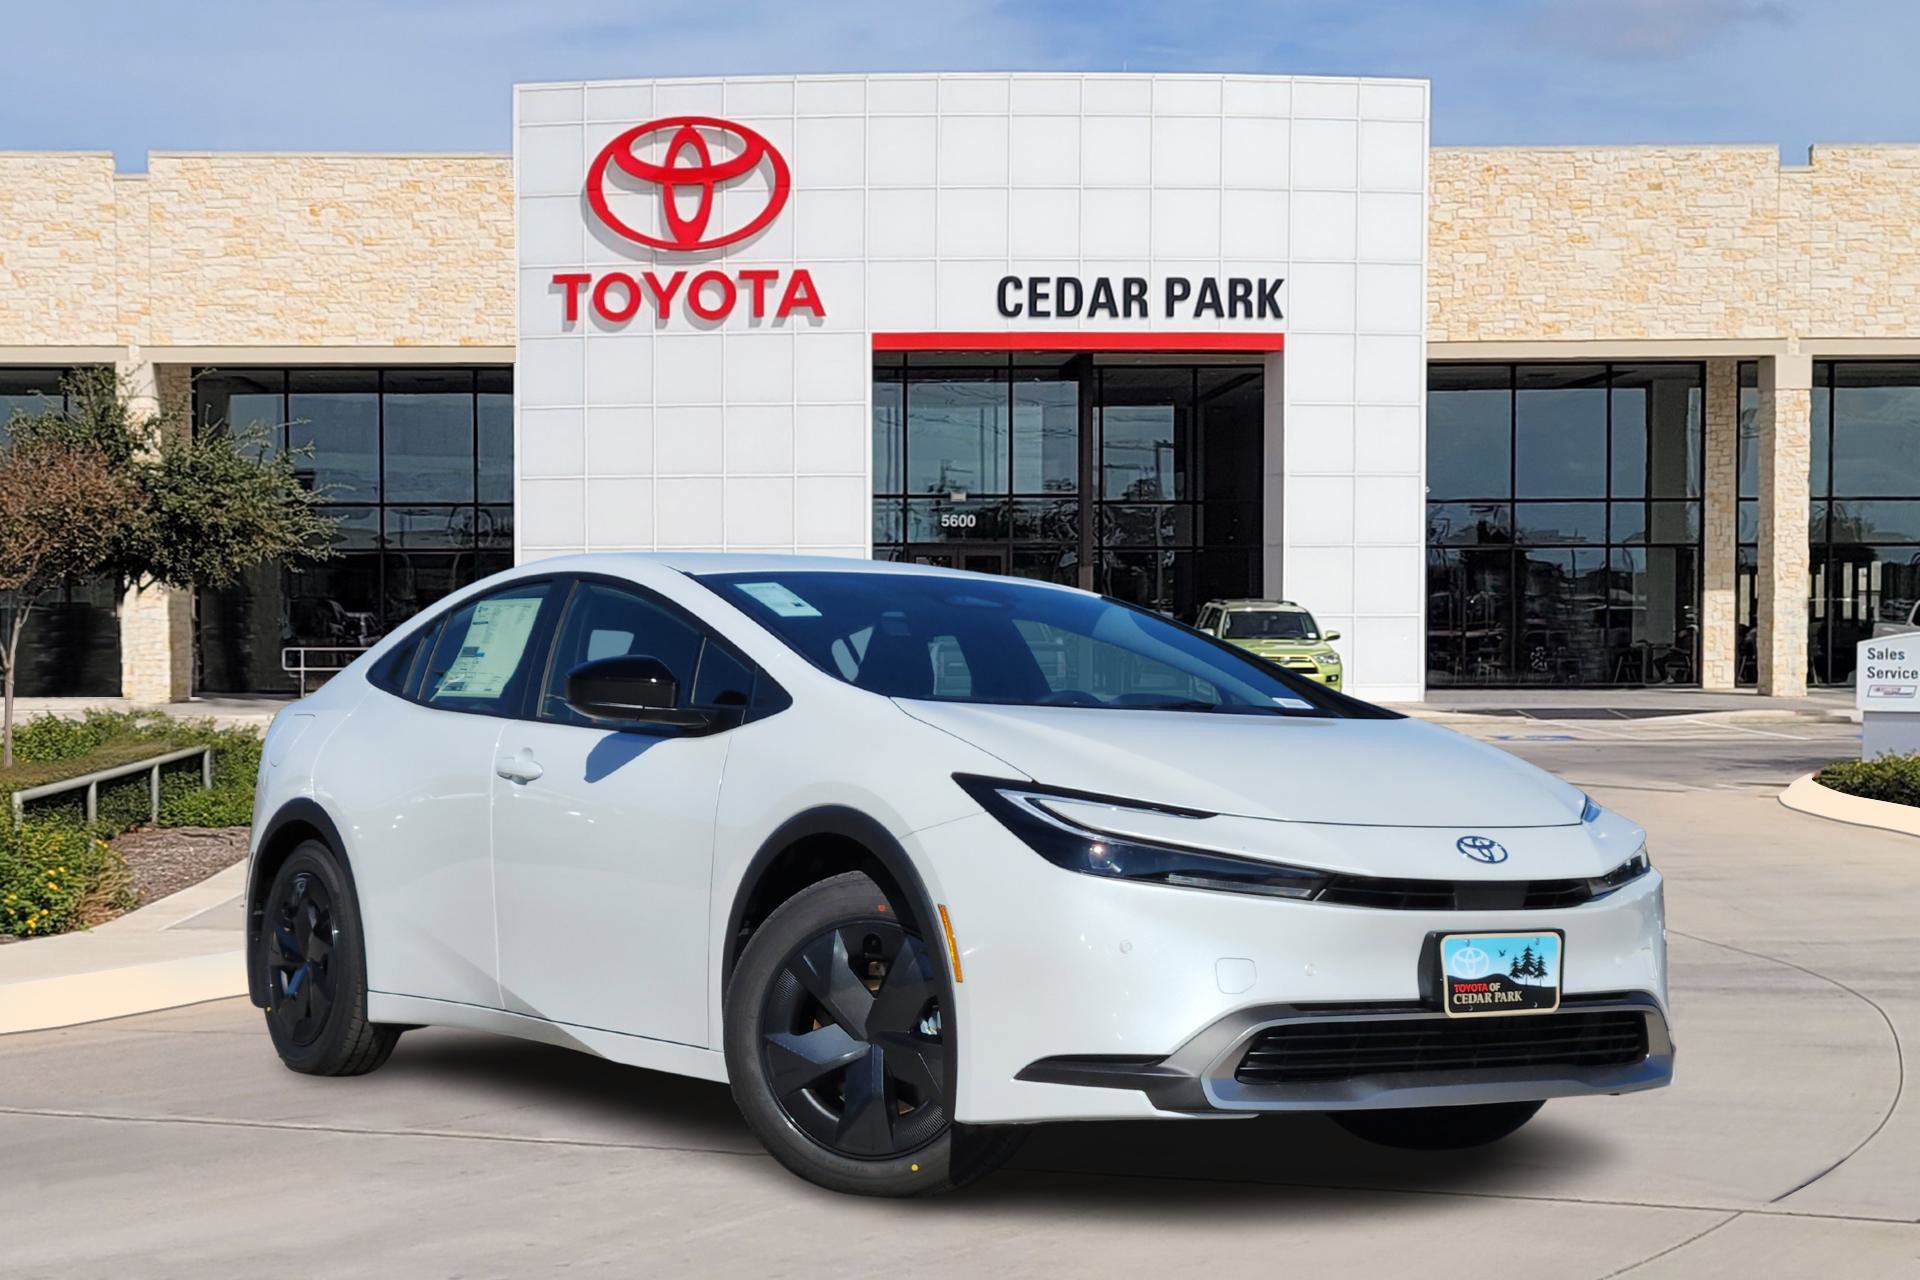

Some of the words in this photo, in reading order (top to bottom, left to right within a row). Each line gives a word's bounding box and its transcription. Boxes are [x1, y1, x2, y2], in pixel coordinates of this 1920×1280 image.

[552, 268, 827, 323] TOYOTA
[997, 276, 1149, 318] CEDAR
[1165, 277, 1285, 319] PARK
[941, 514, 976, 527] 5600
[1867, 647, 1905, 660] Sales
[1867, 666, 1918, 679] Service
[1454, 983, 1488, 993] TOYOTA
[1489, 983, 1500, 991] OF
[1453, 992, 1492, 1004] CEDAR
[1494, 991, 1522, 1003] PARK
